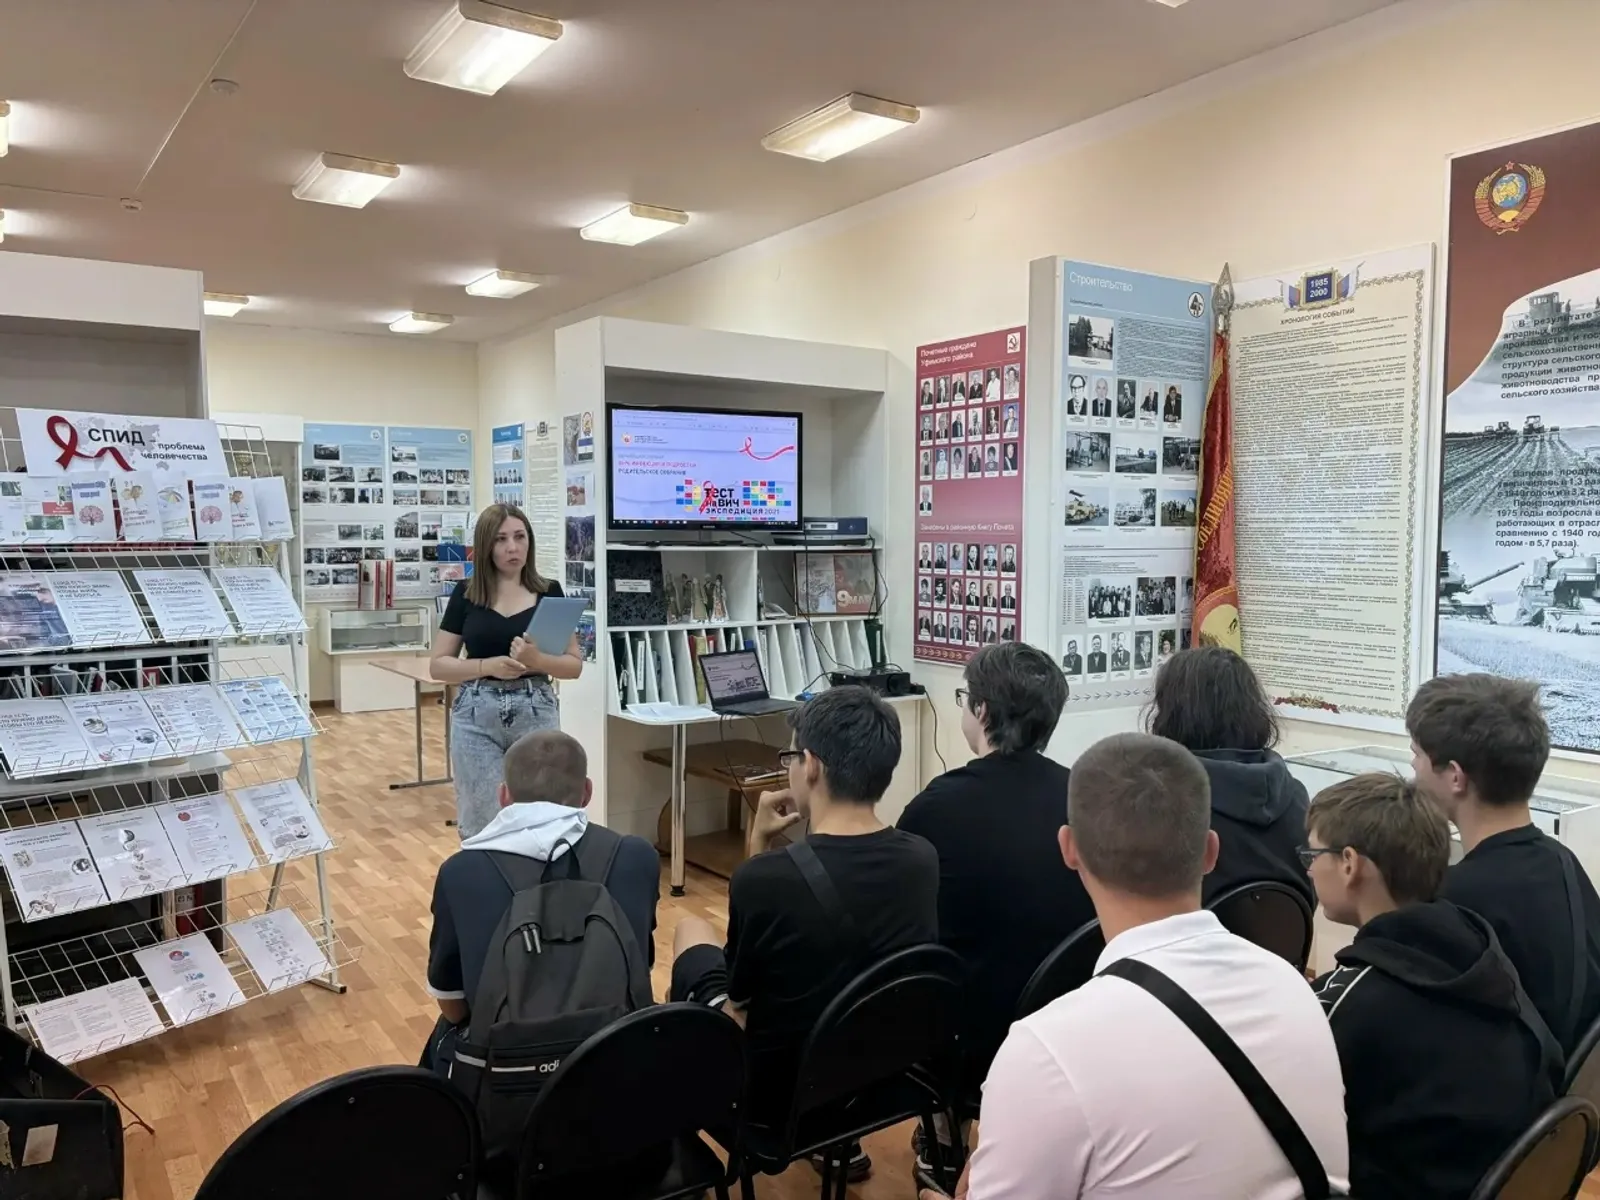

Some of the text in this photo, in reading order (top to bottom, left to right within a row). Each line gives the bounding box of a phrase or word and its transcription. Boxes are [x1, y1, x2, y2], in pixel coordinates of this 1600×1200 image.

[1070, 271, 1133, 292] Строительство
[1310, 278, 1328, 288] 1985
[1310, 288, 1328, 298] 2000
[1280, 308, 1355, 325] ХРОНОЛОГИЯ СОБЫТИЙ
[1533, 312, 1592, 327] результате
[1503, 336, 1569, 350] производства
[1502, 353, 1600, 370] структура сельского
[1501, 368, 1552, 379] продукции
[1501, 376, 1580, 389] животноводства
[1501, 389, 1549, 399] сельского
[88, 428, 145, 446] СПИД
[158, 442, 206, 451] проблема
[141, 452, 208, 460] человечества
[718, 499, 740, 507] ВИЧ
[1551, 540, 1579, 548] раза).
[836, 590, 850, 607] 9
[539, 1060, 560, 1073] adi
